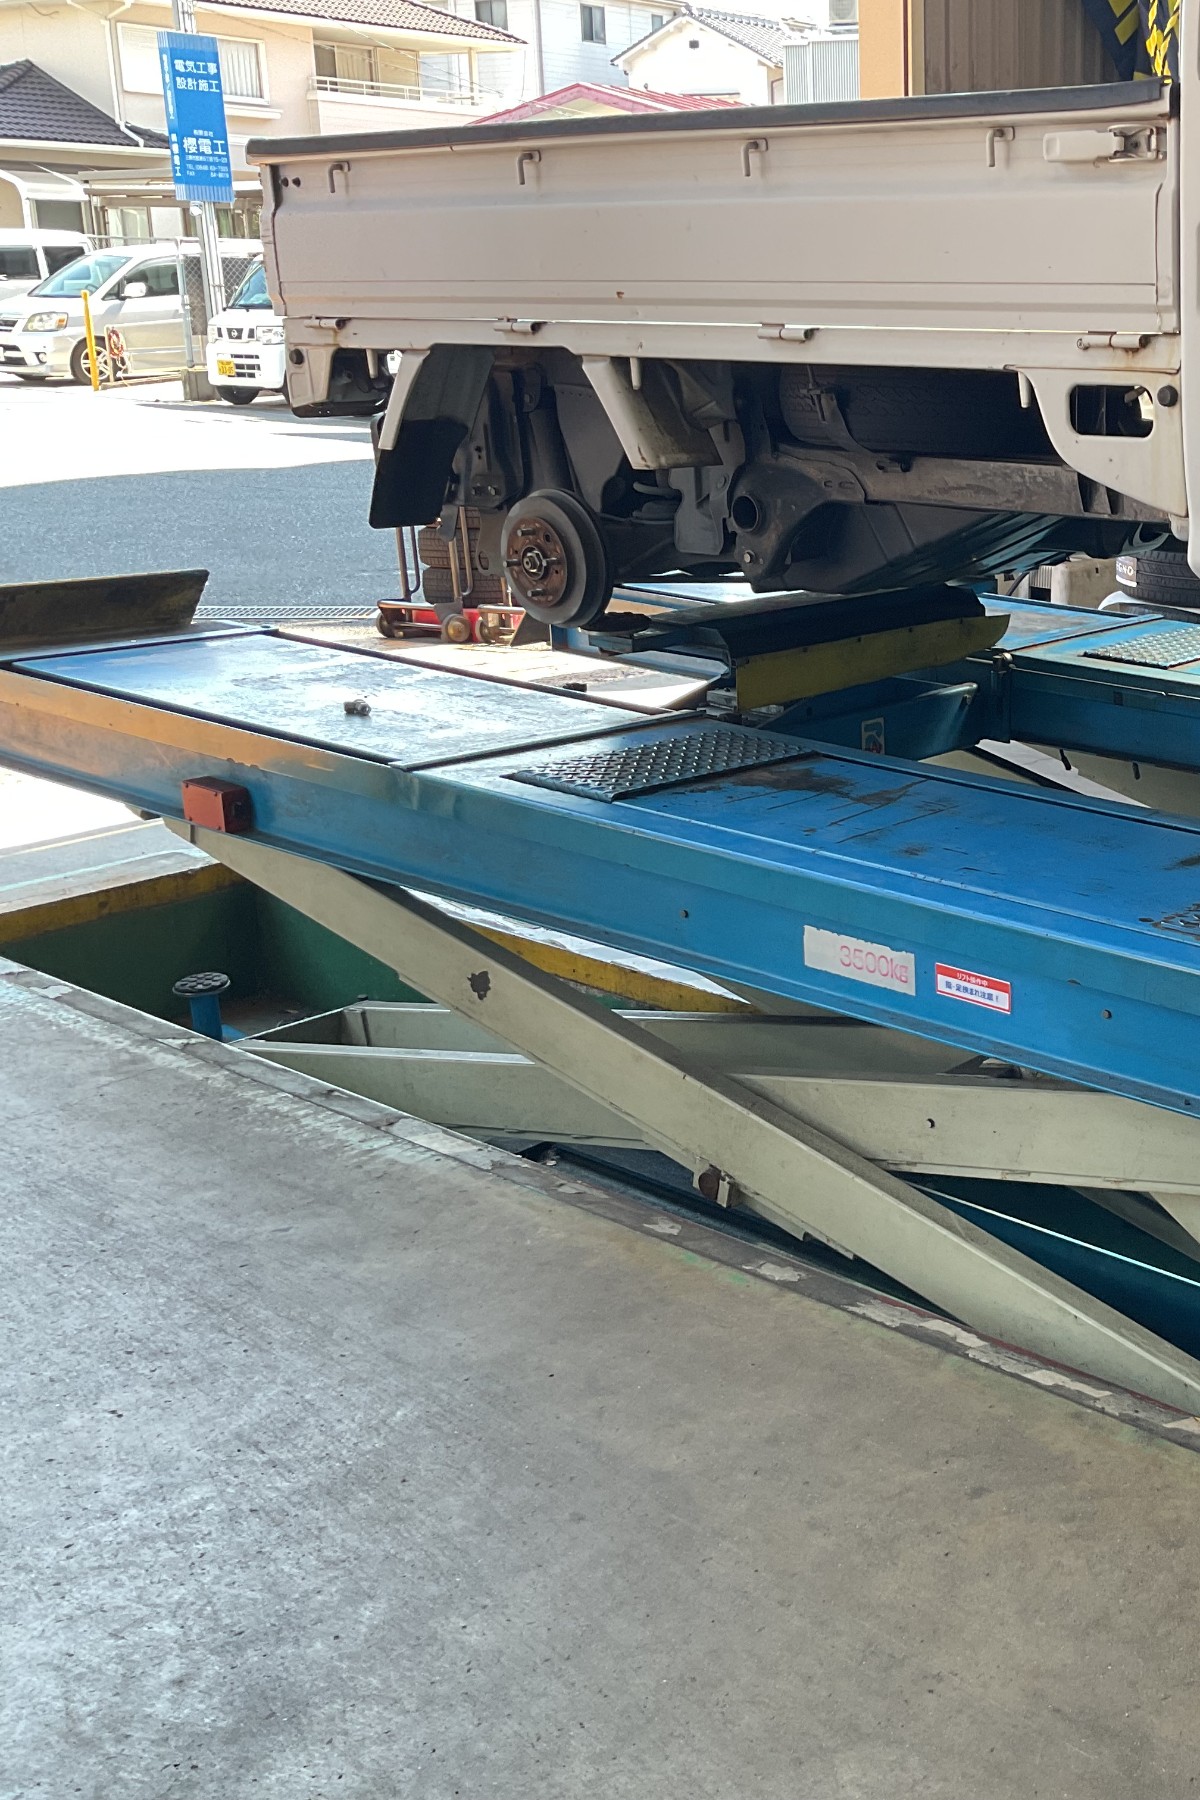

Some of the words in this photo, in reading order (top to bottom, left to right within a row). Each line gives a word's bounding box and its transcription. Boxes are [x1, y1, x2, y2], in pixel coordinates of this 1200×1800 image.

[174, 60, 217, 75] 電気工事
[176, 77, 220, 92] 設計施工
[183, 137, 227, 155] 櫻電工
[956, 972, 988, 987] リフト操作中
